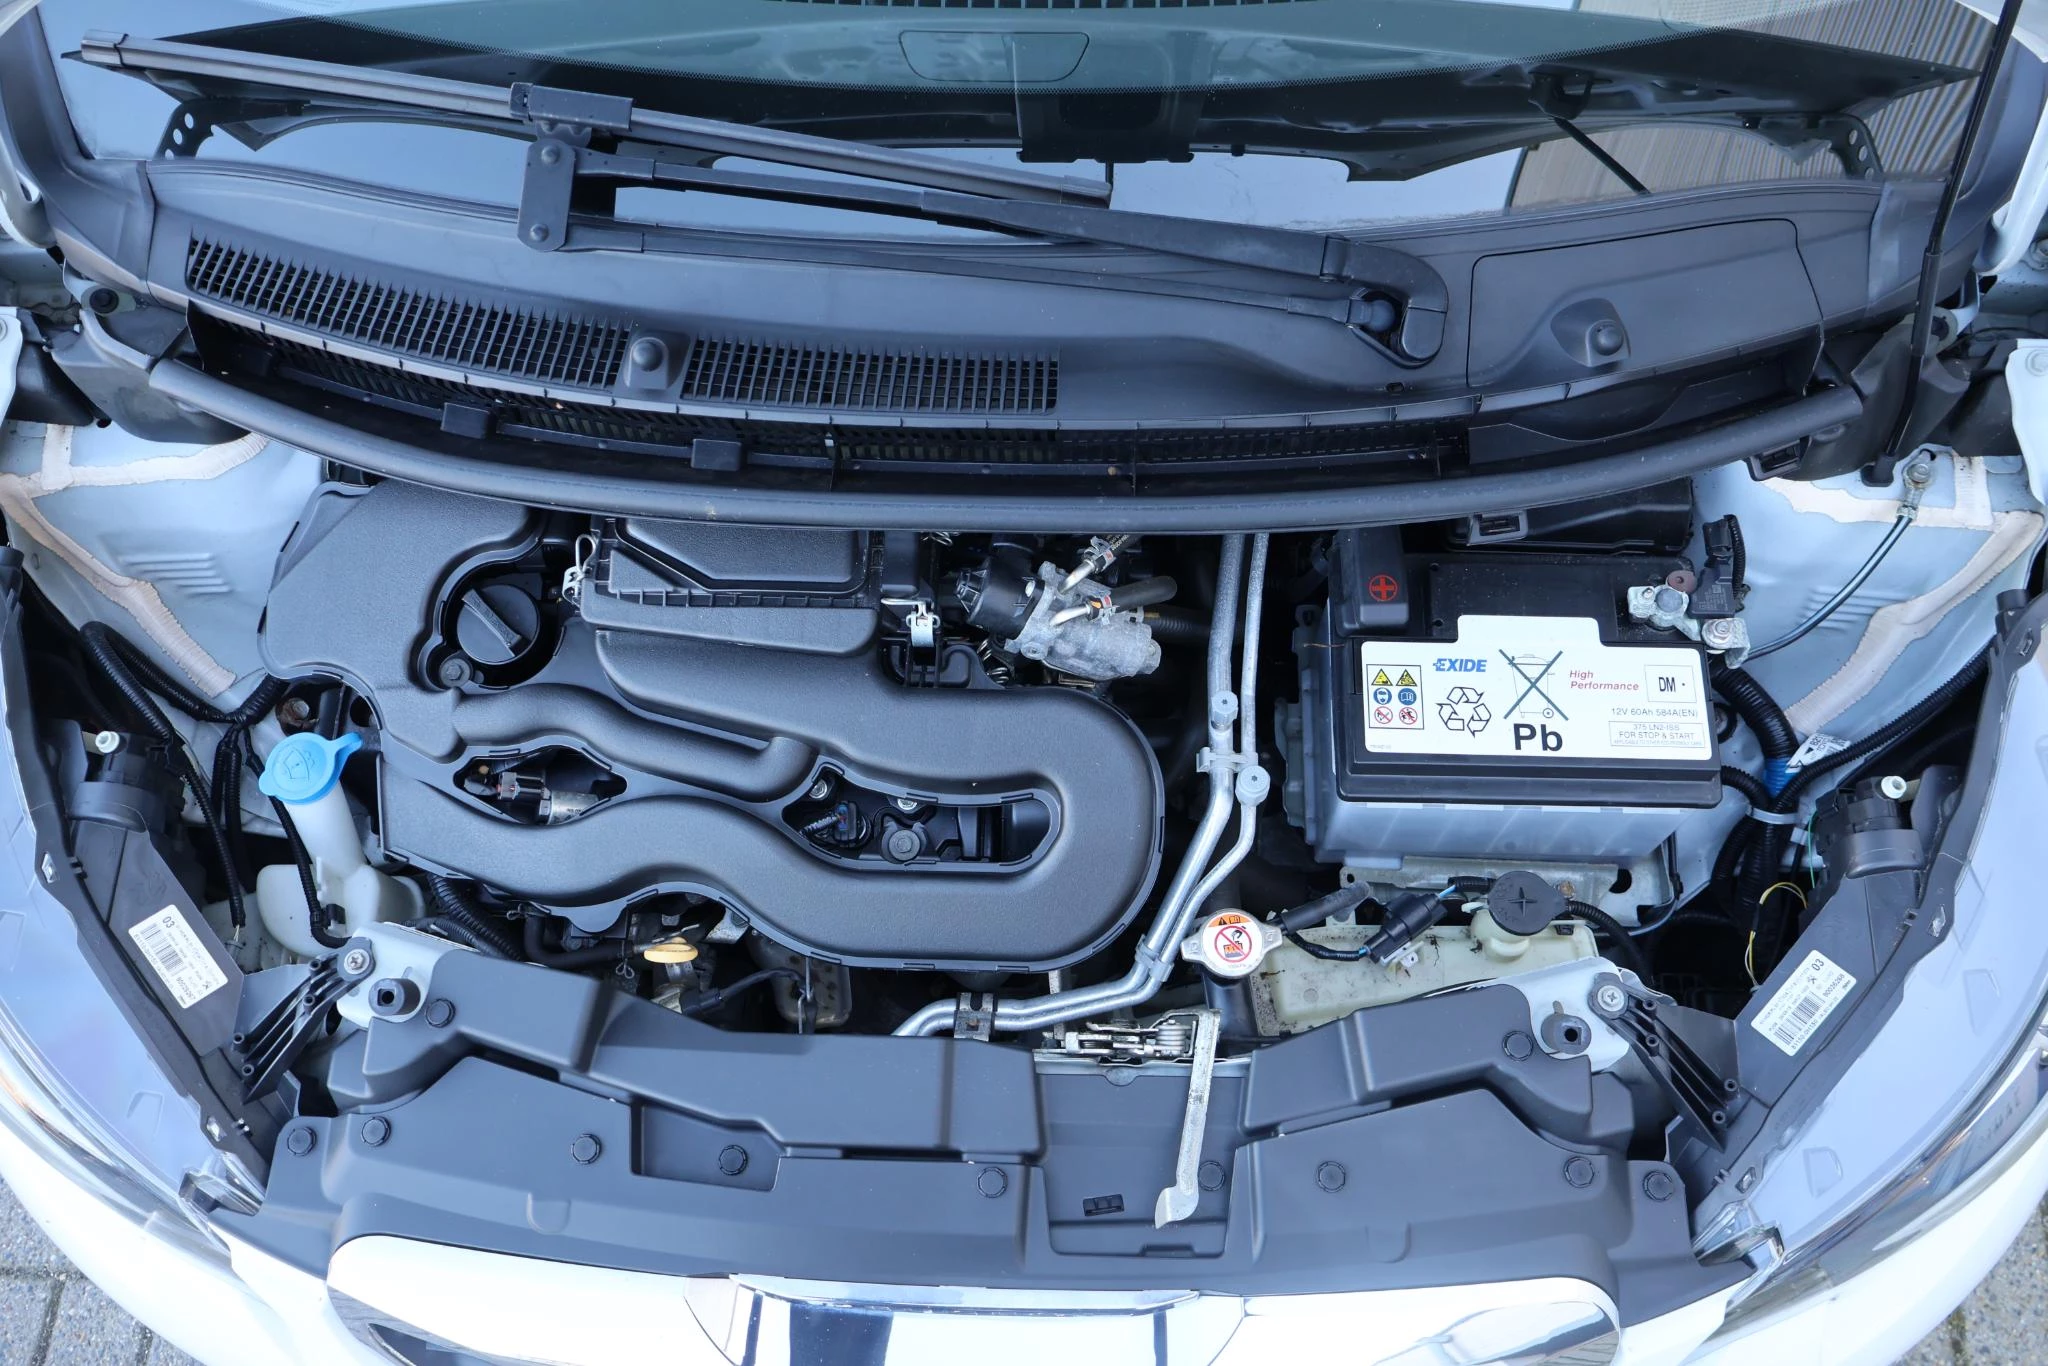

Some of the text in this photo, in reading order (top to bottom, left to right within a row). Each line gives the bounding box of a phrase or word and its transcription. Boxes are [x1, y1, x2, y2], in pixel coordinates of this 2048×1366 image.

[1433, 658, 1487, 672] EXIDE
[1569, 670, 1594, 680] High
[1570, 681, 1639, 691] Performance
[1658, 676, 1676, 692] DM
[1612, 708, 1628, 716] 12V
[1631, 708, 1653, 716] 60Ah
[1513, 723, 1563, 751] Pb
[1619, 731, 1636, 739] FOR
[1639, 731, 1660, 739] STOP
[1669, 732, 1695, 740] START
[162, 916, 175, 928] 03
[1811, 958, 1825, 971] 03
